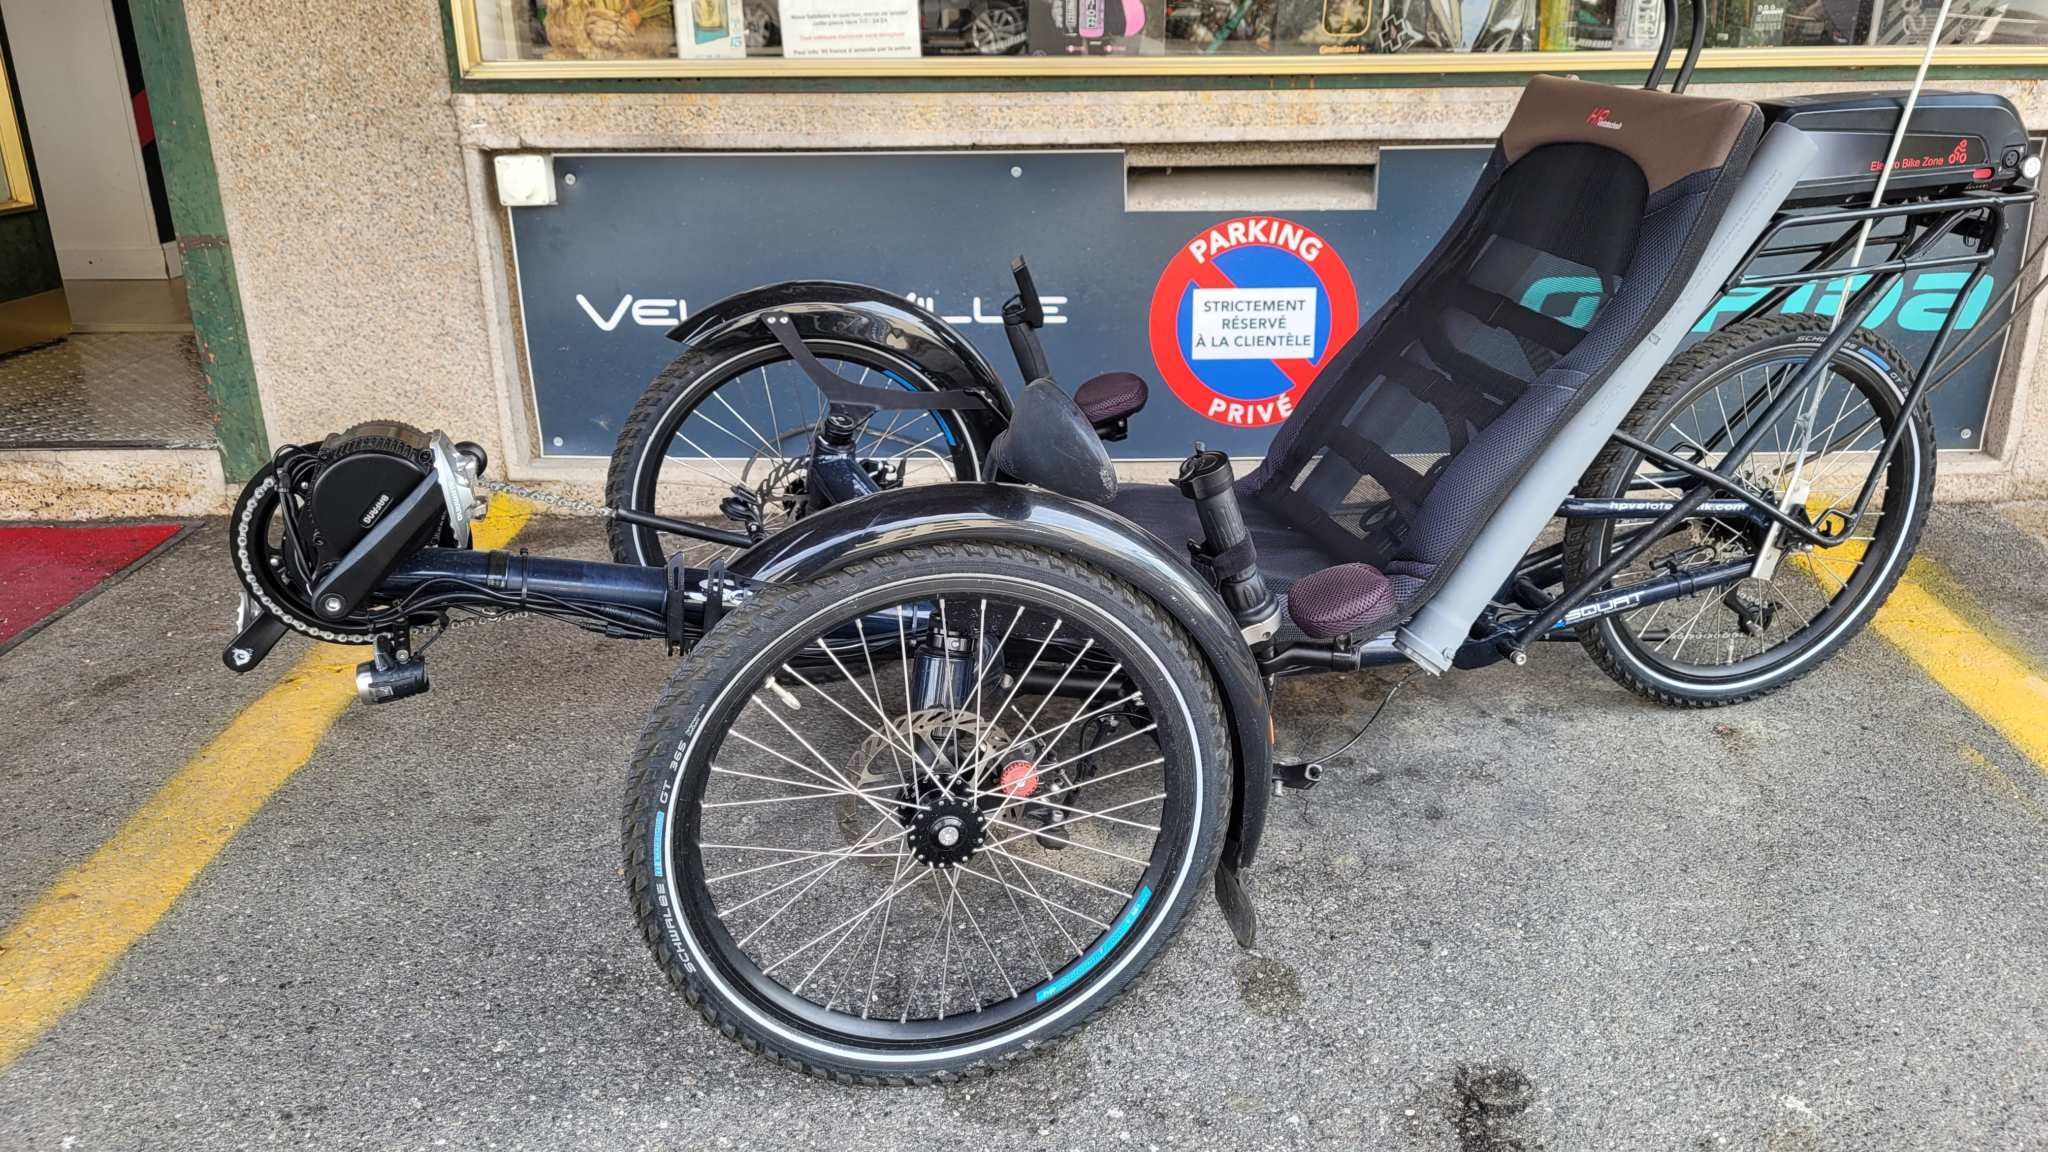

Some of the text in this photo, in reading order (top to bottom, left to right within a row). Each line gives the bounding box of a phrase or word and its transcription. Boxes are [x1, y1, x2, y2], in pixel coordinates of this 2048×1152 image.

[1901, 158, 1921, 169] Bike
[1922, 156, 1944, 167] Zone
[1188, 219, 1324, 264] PARKING
[1203, 300, 1306, 313] STRICTEMENT
[1221, 316, 1287, 330] RÉSERVÉ
[1195, 331, 1312, 348] À LA CLIENTÈLE
[1207, 391, 1294, 424] PRIVÉ
[659, 779, 672, 805] GT
[670, 740, 687, 772] 365
[656, 882, 697, 974] SCHWALBE
